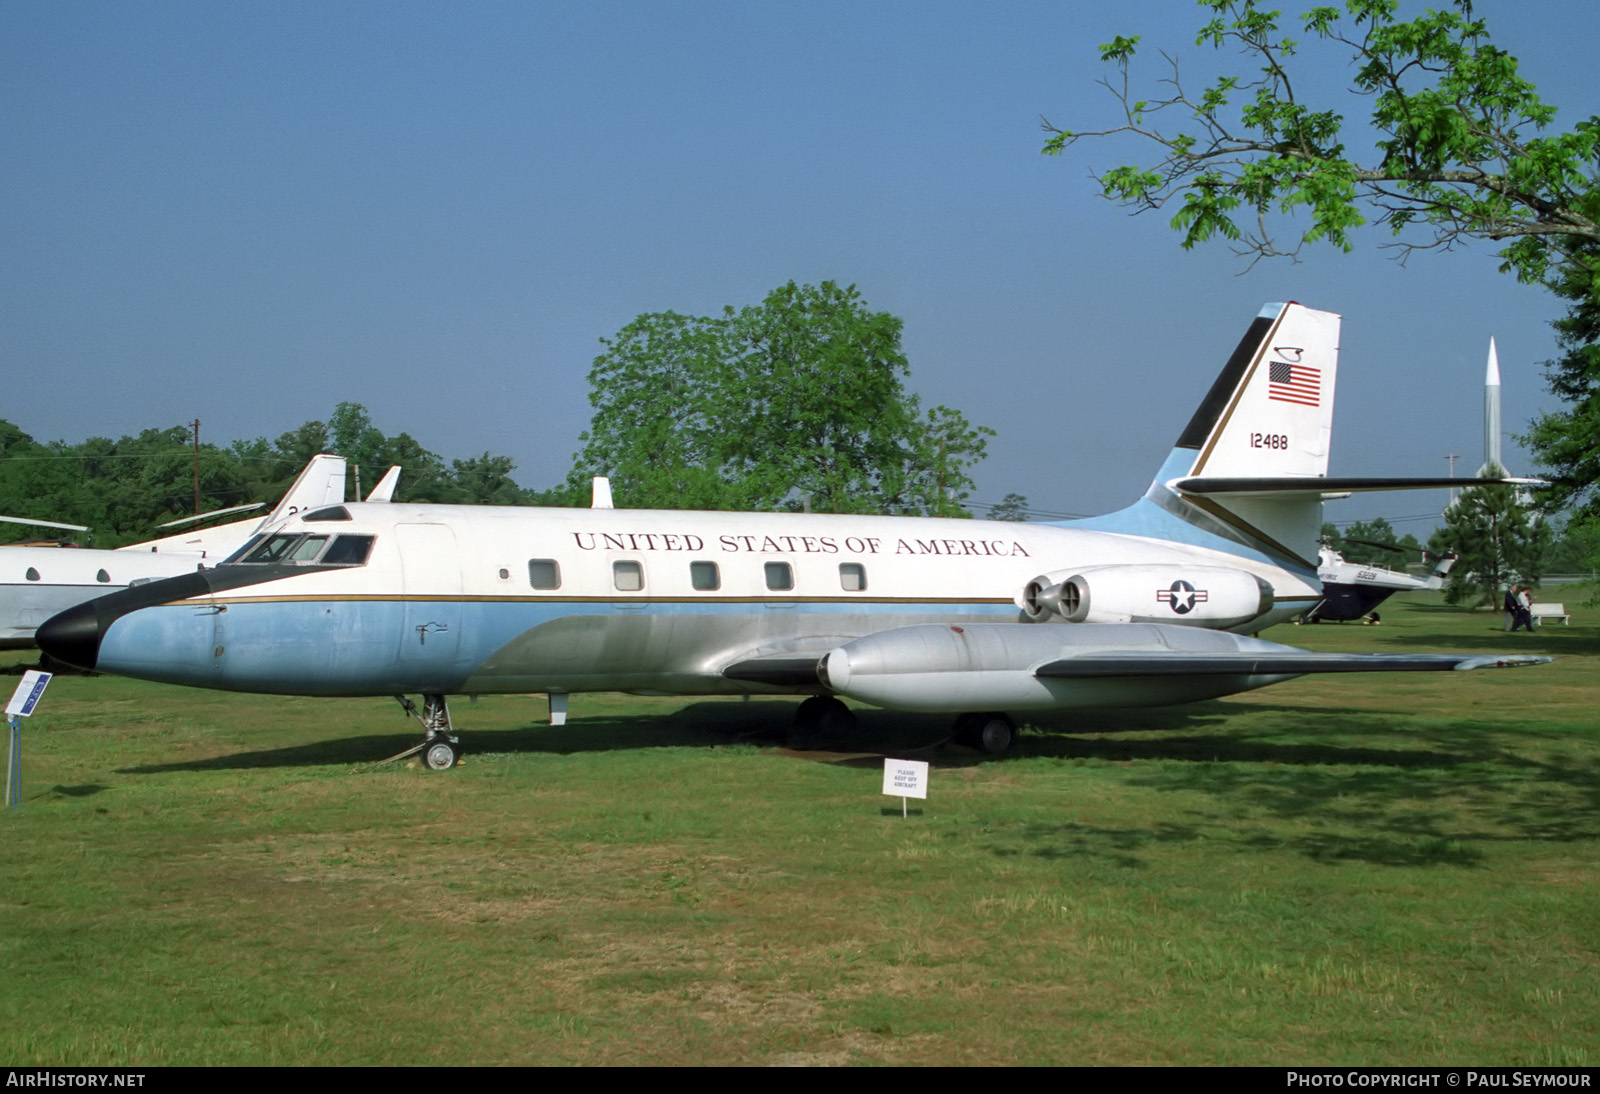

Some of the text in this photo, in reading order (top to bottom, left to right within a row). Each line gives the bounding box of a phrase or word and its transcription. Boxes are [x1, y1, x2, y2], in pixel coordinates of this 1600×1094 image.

[1250, 432, 1288, 450] 12488
[572, 532, 1030, 557] UNITED STATES OF AMERICA
[894, 781, 917, 789] AIRCRAFT
